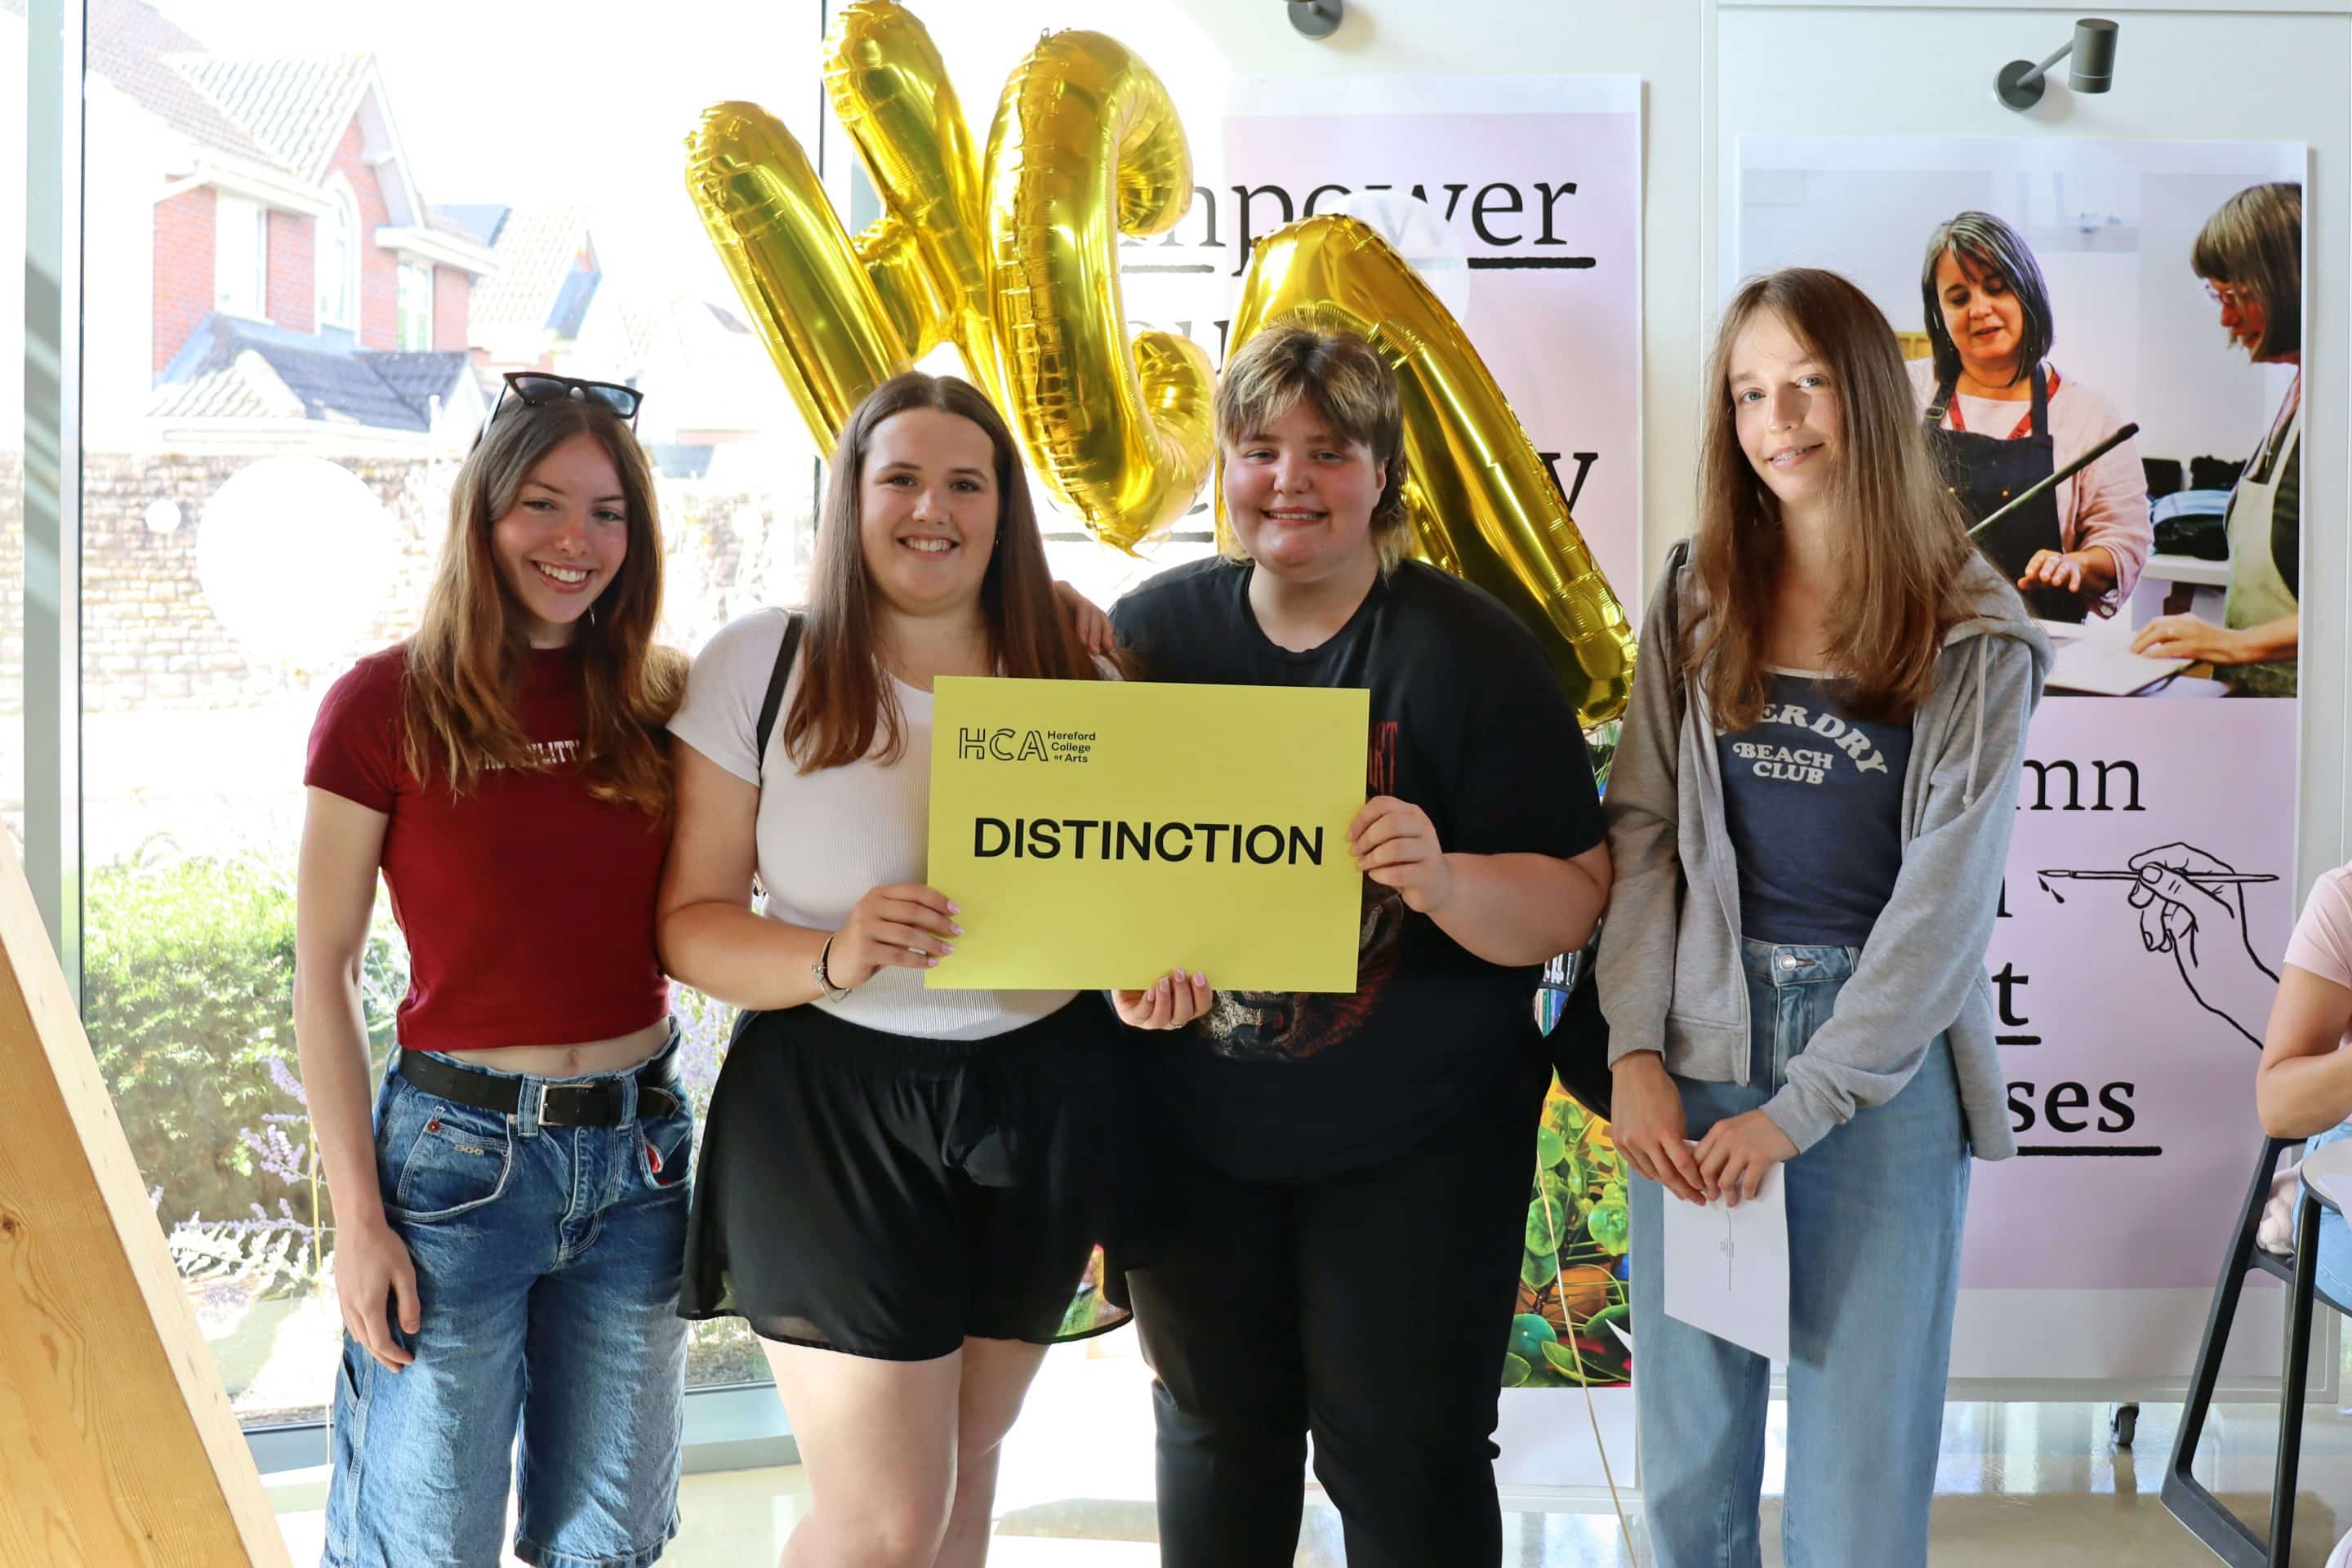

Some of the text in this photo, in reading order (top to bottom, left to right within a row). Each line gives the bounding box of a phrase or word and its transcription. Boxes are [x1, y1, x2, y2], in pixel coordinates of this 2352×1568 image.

[959, 727, 1049, 762] HCA
[1047, 730, 1097, 742] Hereford
[1051, 742, 1092, 754] College
[1716, 703, 1888, 774] ERDRY
[1064, 753, 1089, 764] Arts
[1732, 742, 1834, 769] BEACH
[1753, 760, 1826, 785] CLUB
[973, 817, 1325, 866] DISTINCTION
